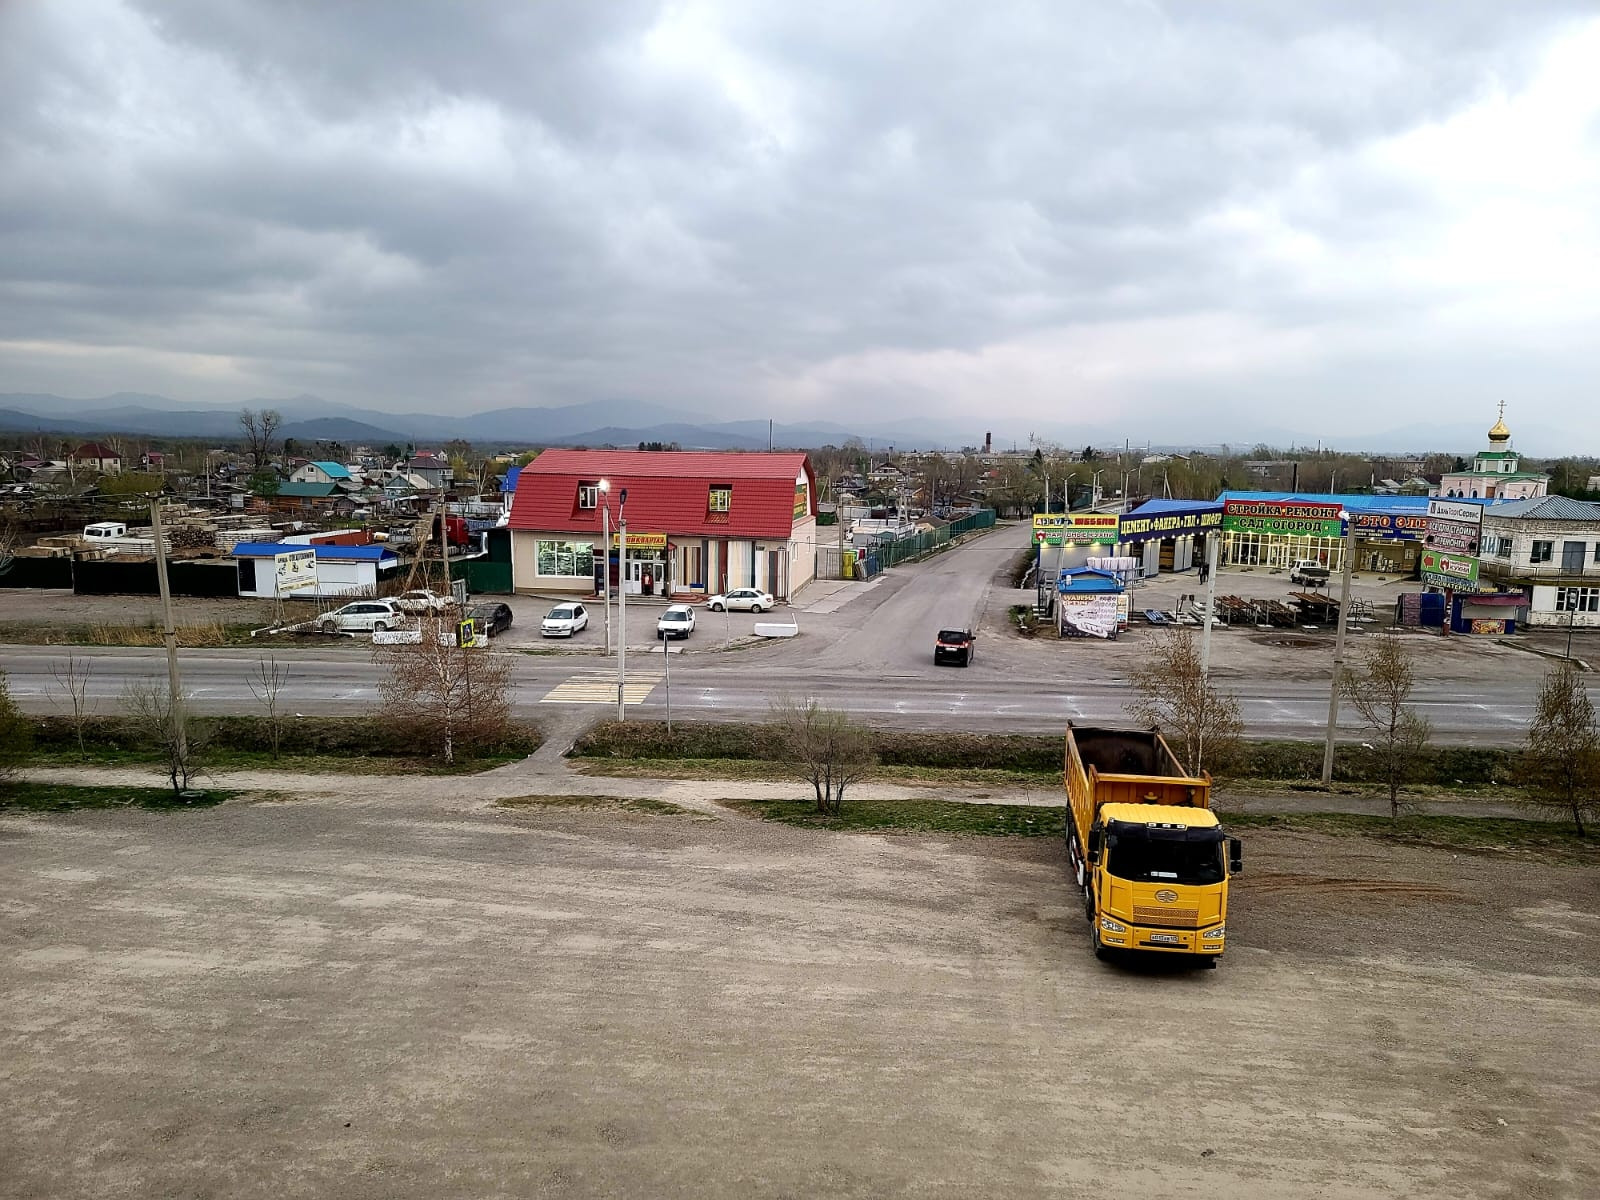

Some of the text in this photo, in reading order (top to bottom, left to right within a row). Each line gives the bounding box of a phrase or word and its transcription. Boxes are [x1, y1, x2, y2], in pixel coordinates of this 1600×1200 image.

[1228, 502, 1337, 518] СТРОЙКА РЕМОНТ
[1121, 519, 1151, 535] ЦЕМЕНТ
[1153, 516, 1181, 531] ФАНЕРА
[1239, 518, 1322, 533] САД ОГОРОД
[1356, 515, 1390, 527] ВТО
